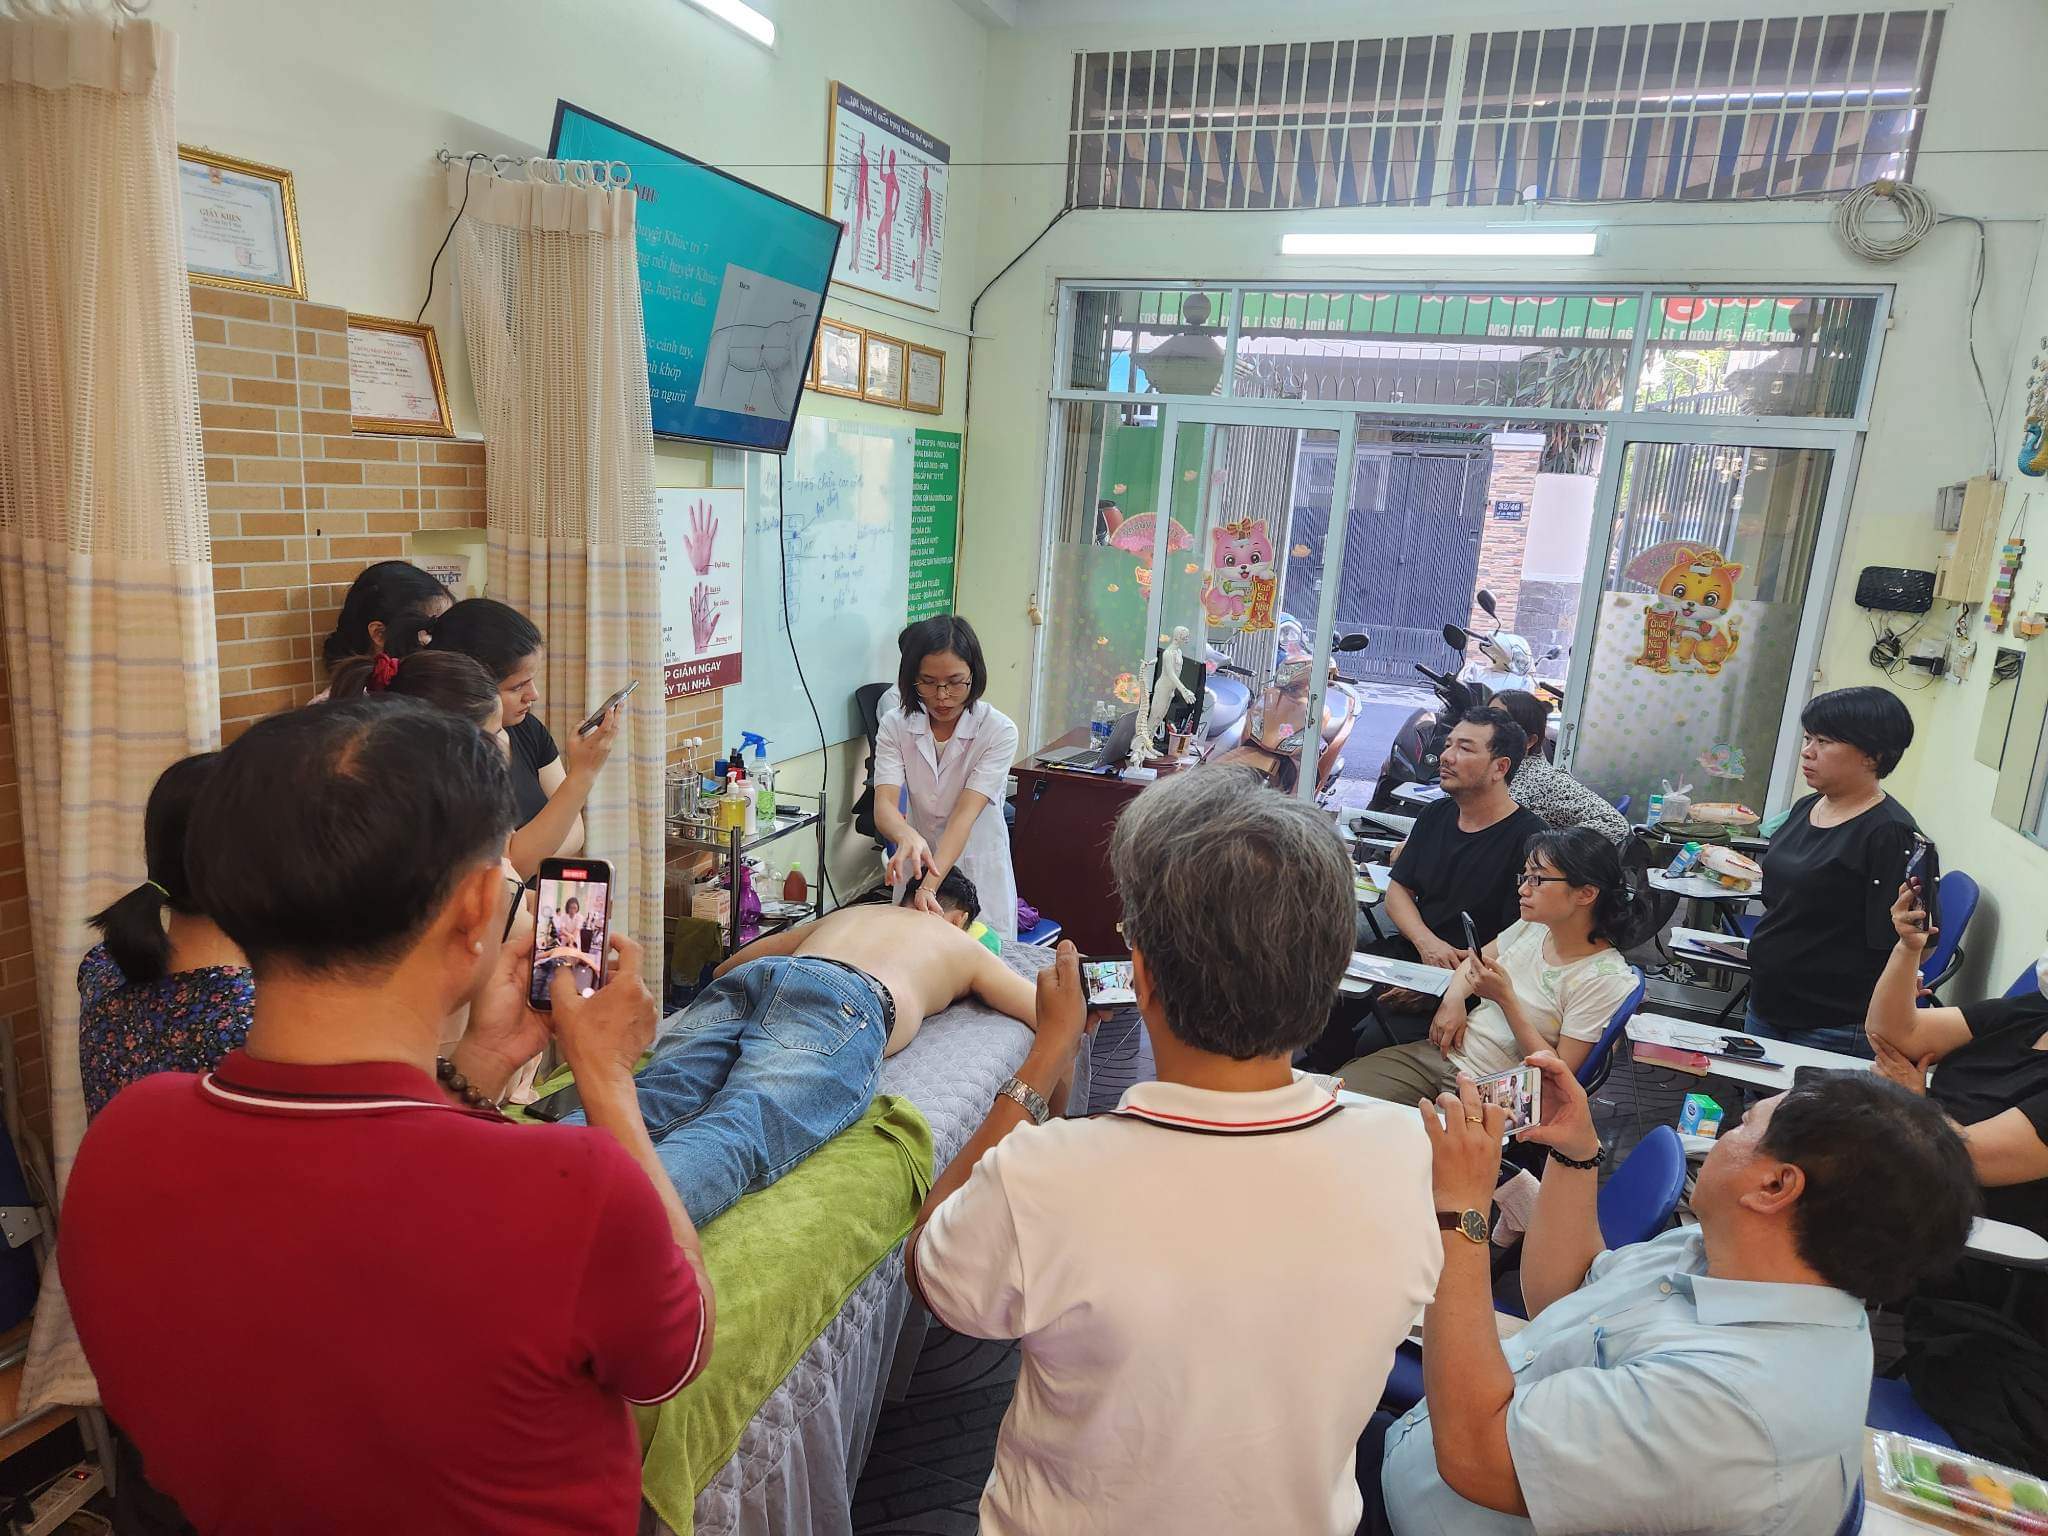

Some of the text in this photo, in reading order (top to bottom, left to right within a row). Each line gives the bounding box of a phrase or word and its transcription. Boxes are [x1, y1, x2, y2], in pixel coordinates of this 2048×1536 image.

[673, 663, 697, 679] GIẢM
[698, 660, 722, 675] NGAY
[675, 681, 690, 695] TẠI
[691, 675, 712, 691] NHÀ
